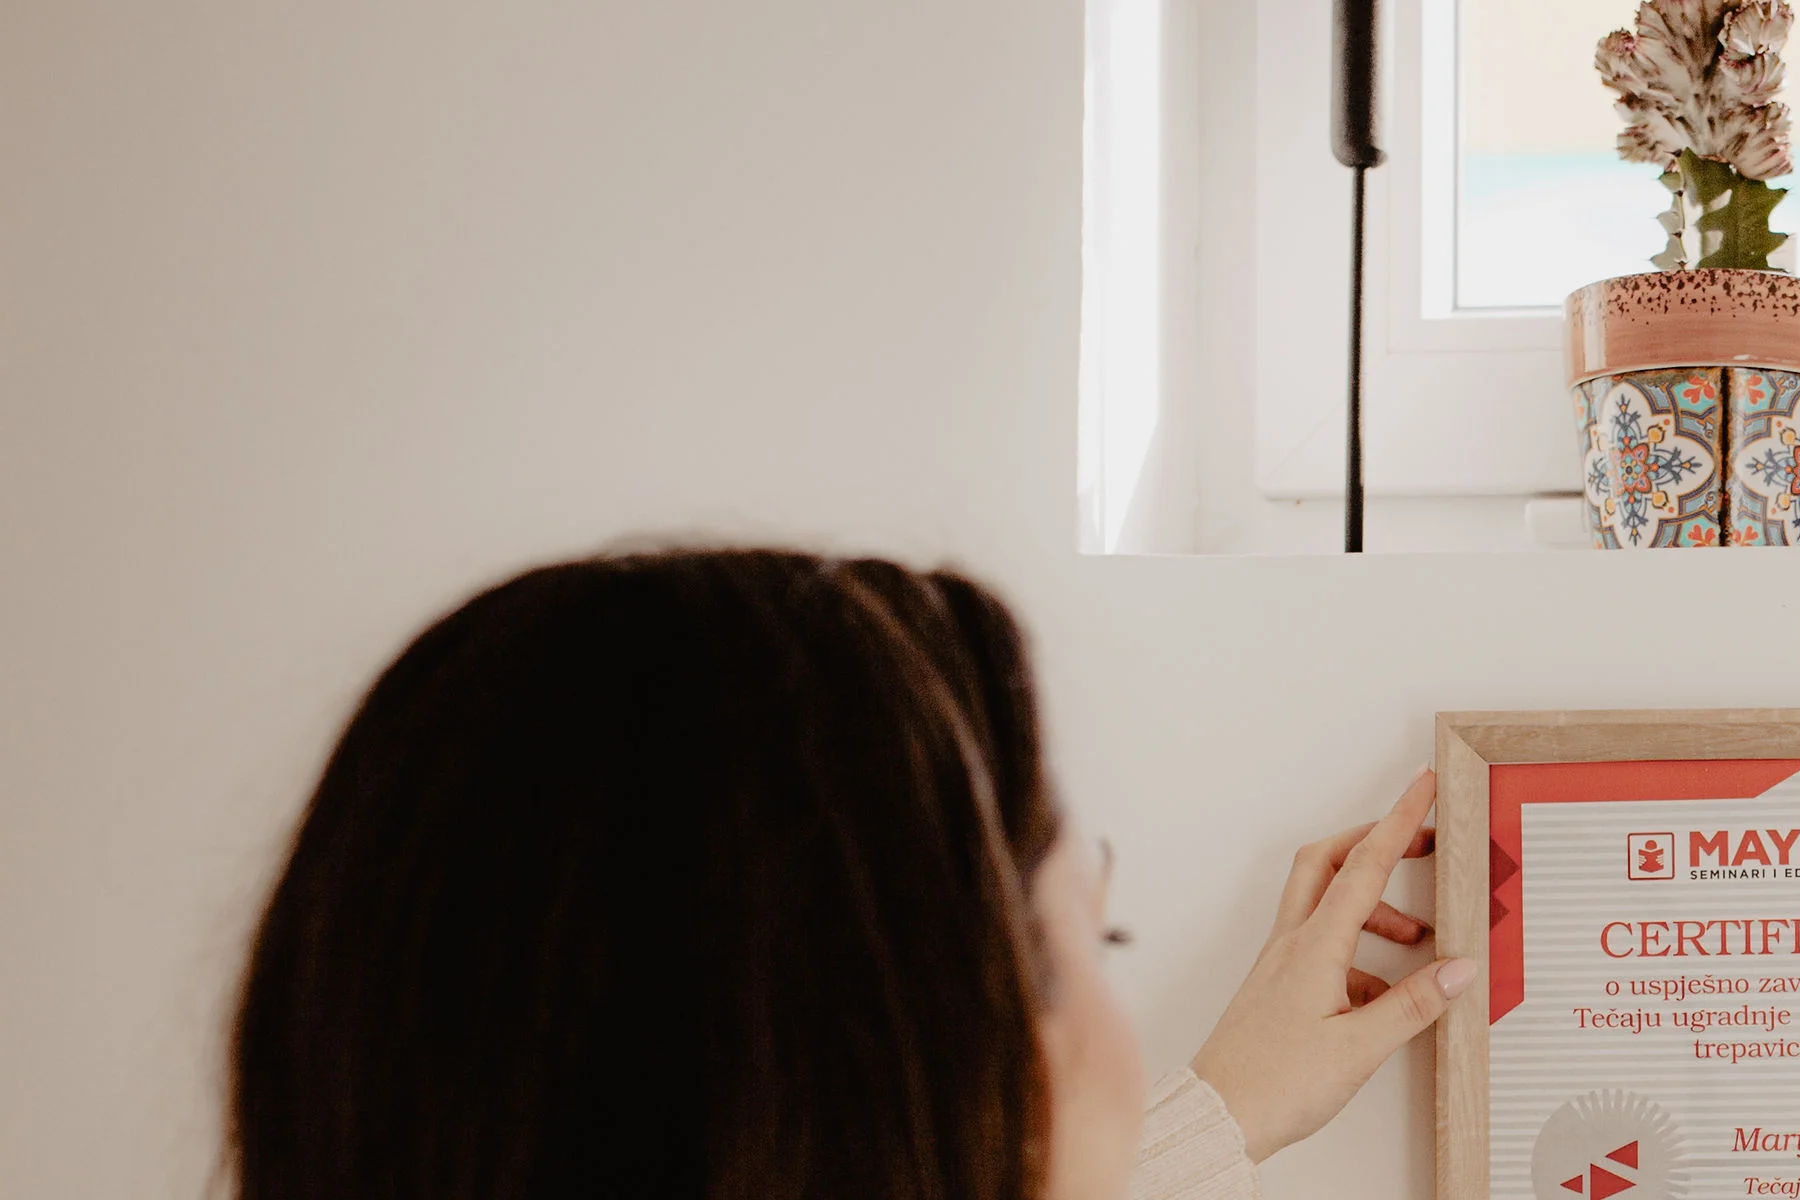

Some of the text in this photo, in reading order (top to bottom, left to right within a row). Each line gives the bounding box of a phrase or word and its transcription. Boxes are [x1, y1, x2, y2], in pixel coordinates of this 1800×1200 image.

[1690, 869, 1767, 880] SEMINARI
[1773, 868, 1778, 879] I
[1605, 981, 1620, 997] o
[1630, 974, 1750, 1001] uspješno
[1573, 1007, 1662, 1034] Tečaju
[1672, 1005, 1792, 1033] ugradnje
[1744, 1176, 1800, 1200] Tečaj
